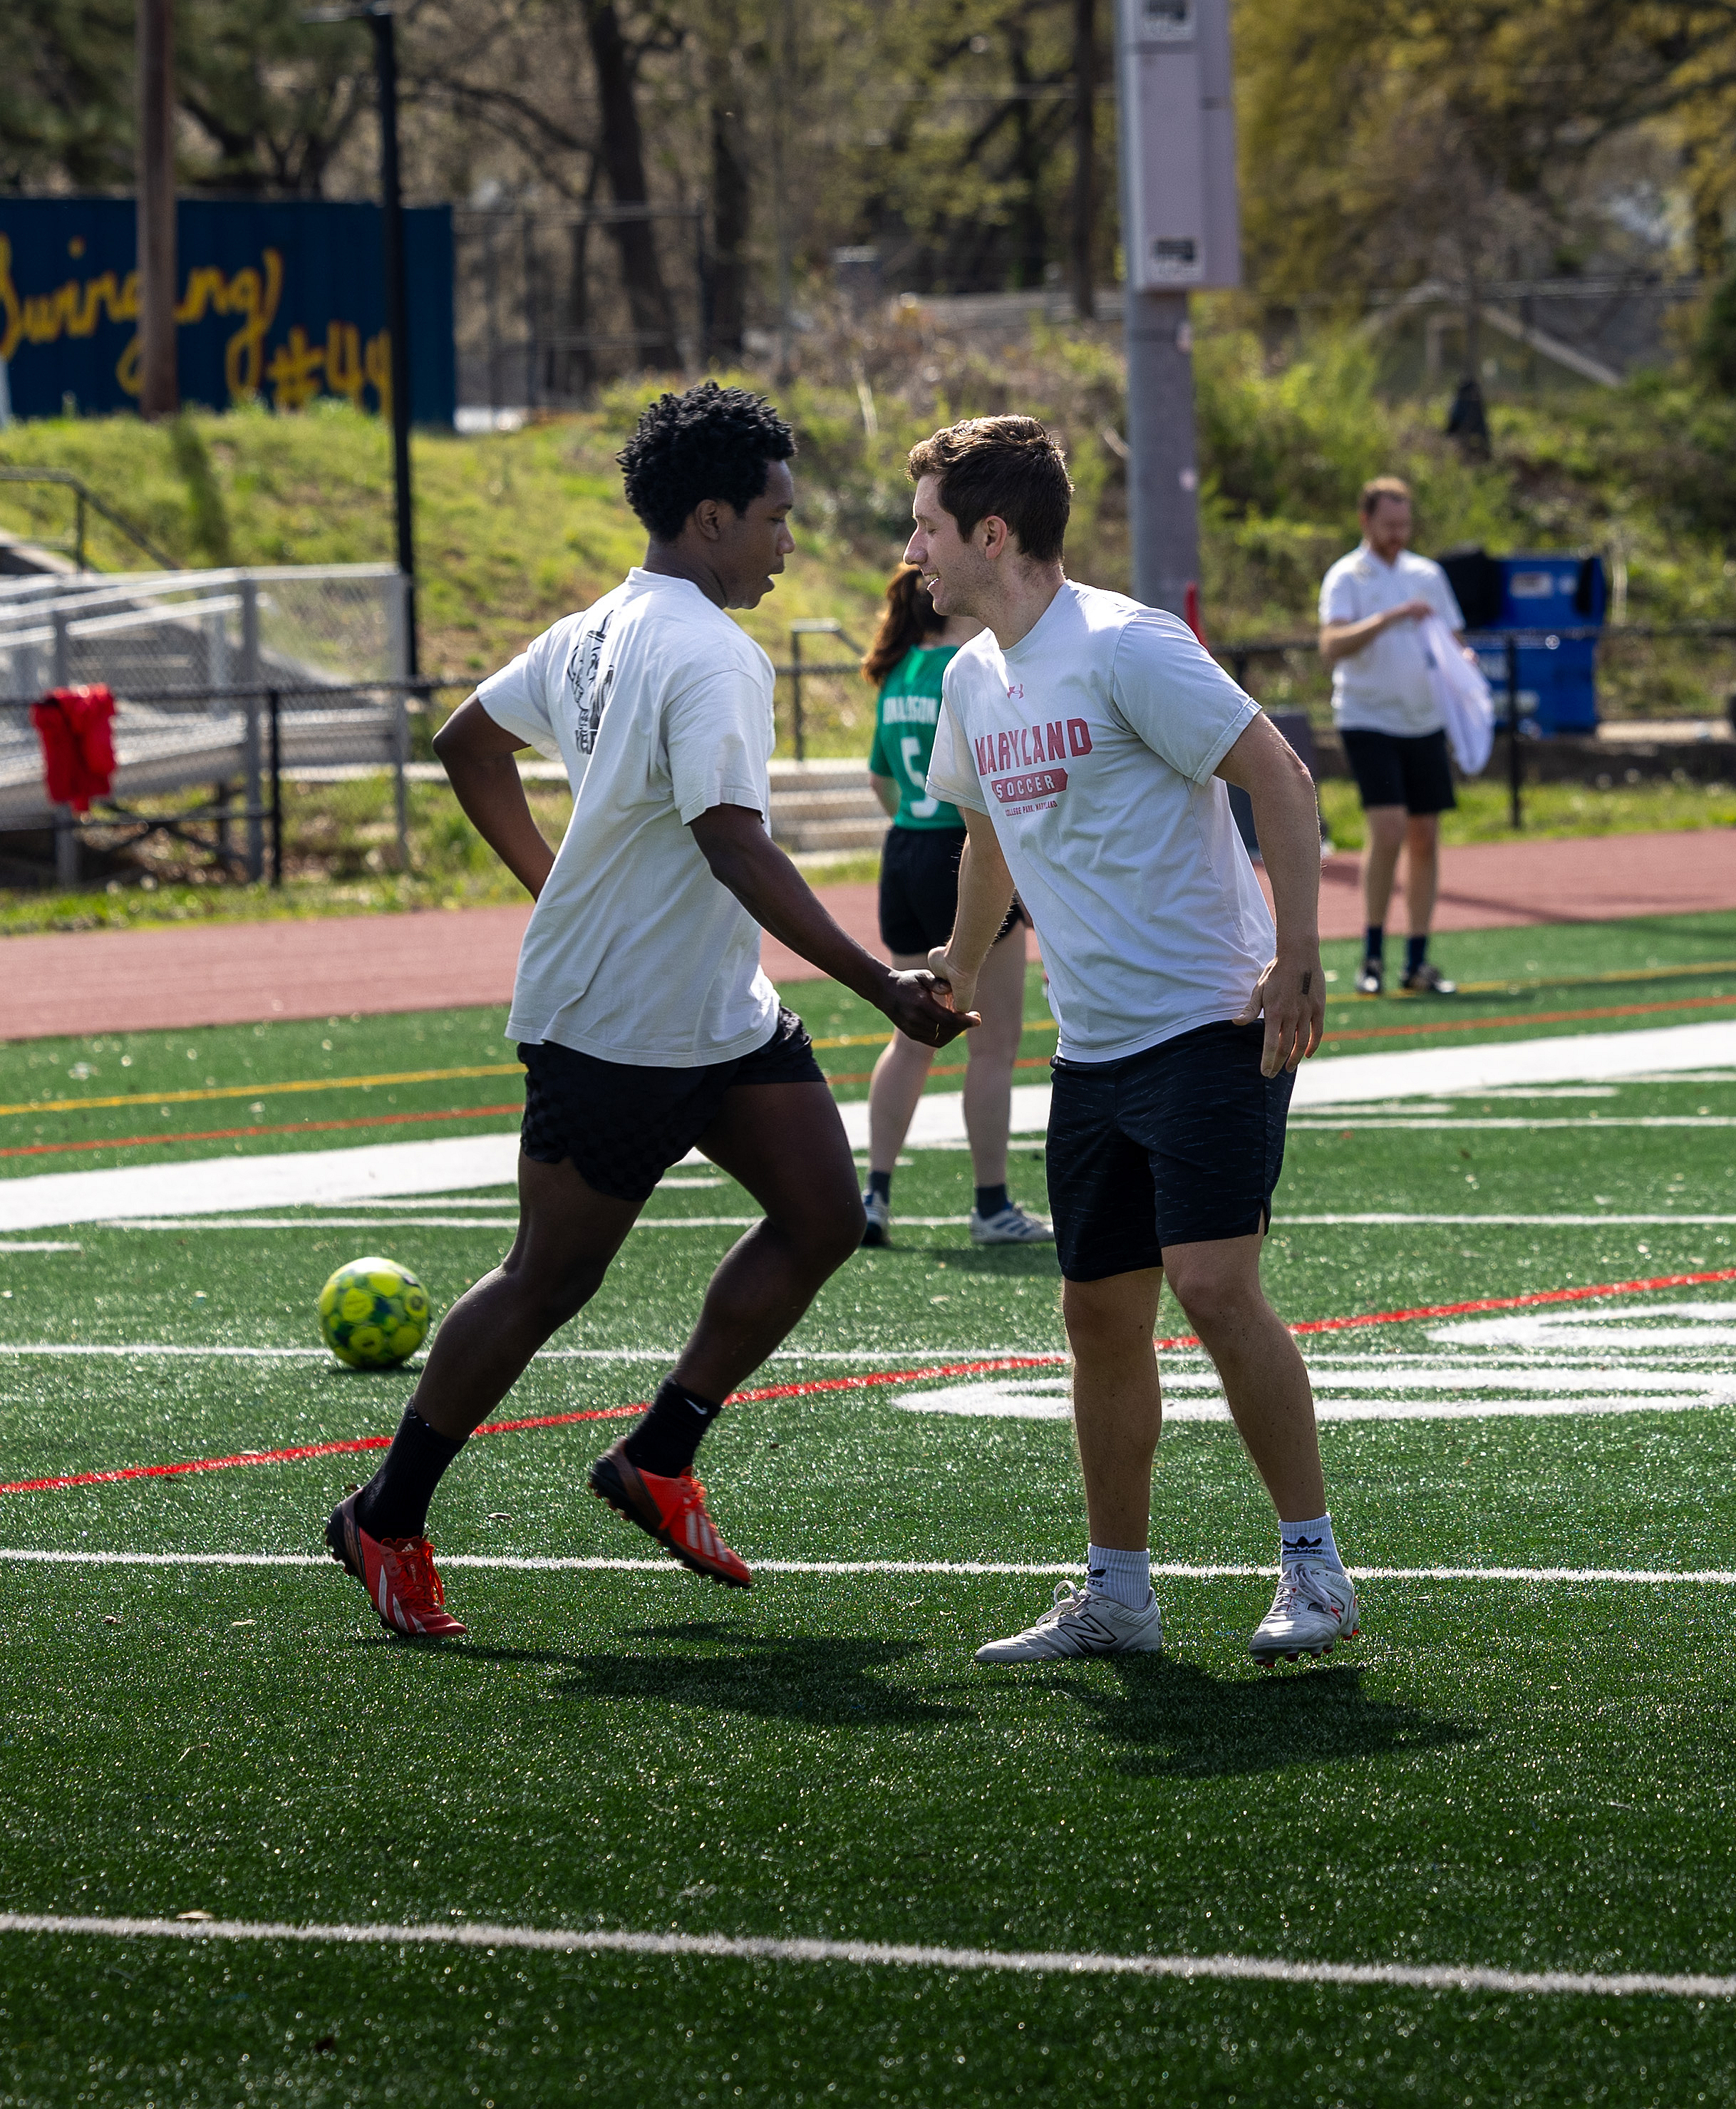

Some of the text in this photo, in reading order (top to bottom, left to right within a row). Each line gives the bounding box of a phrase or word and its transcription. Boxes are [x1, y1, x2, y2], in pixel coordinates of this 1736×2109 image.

[975, 717, 1093, 776] MARYLAND
[901, 736, 939, 818] 5
[996, 774, 1055, 799] SOCCER
